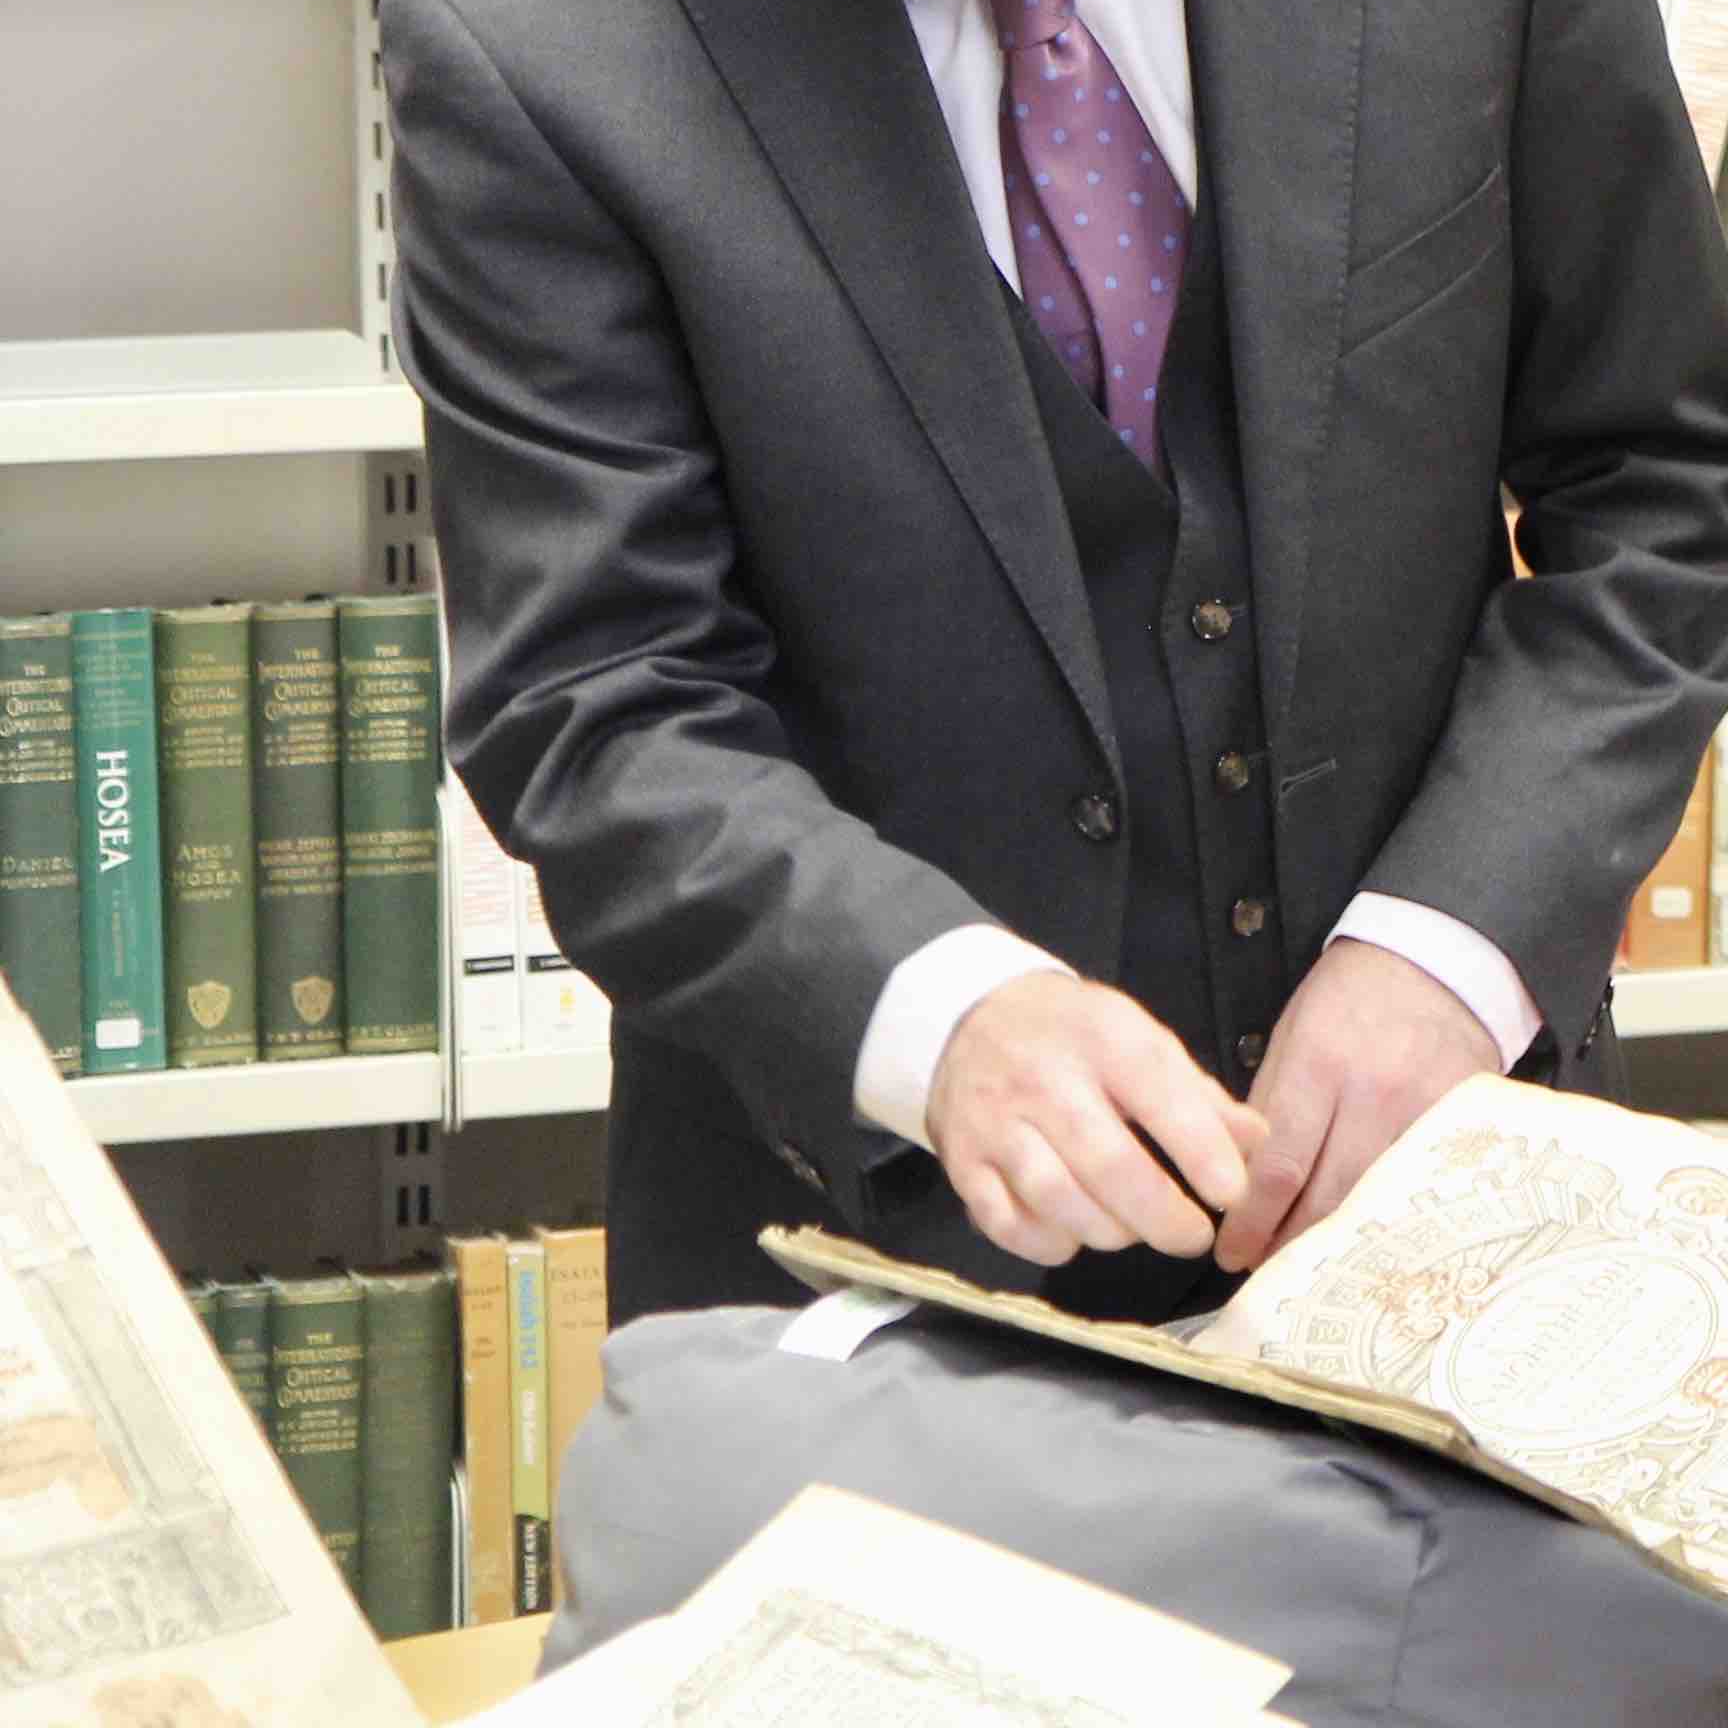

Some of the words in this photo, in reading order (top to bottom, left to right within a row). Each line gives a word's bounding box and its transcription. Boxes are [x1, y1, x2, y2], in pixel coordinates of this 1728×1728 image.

[294, 648, 320, 661] THE
[23, 664, 47, 677] THE
[169, 683, 237, 705] CRITICAL
[354, 676, 419, 696] CRITICAL
[4, 697, 64, 719] CRITICAL
[95, 750, 132, 873] HOSEA
[176, 843, 234, 862] AMOS
[1, 857, 74, 873] DANIEL
[172, 868, 243, 888] HOSEA
[287, 1365, 353, 1386] CRITICAL
